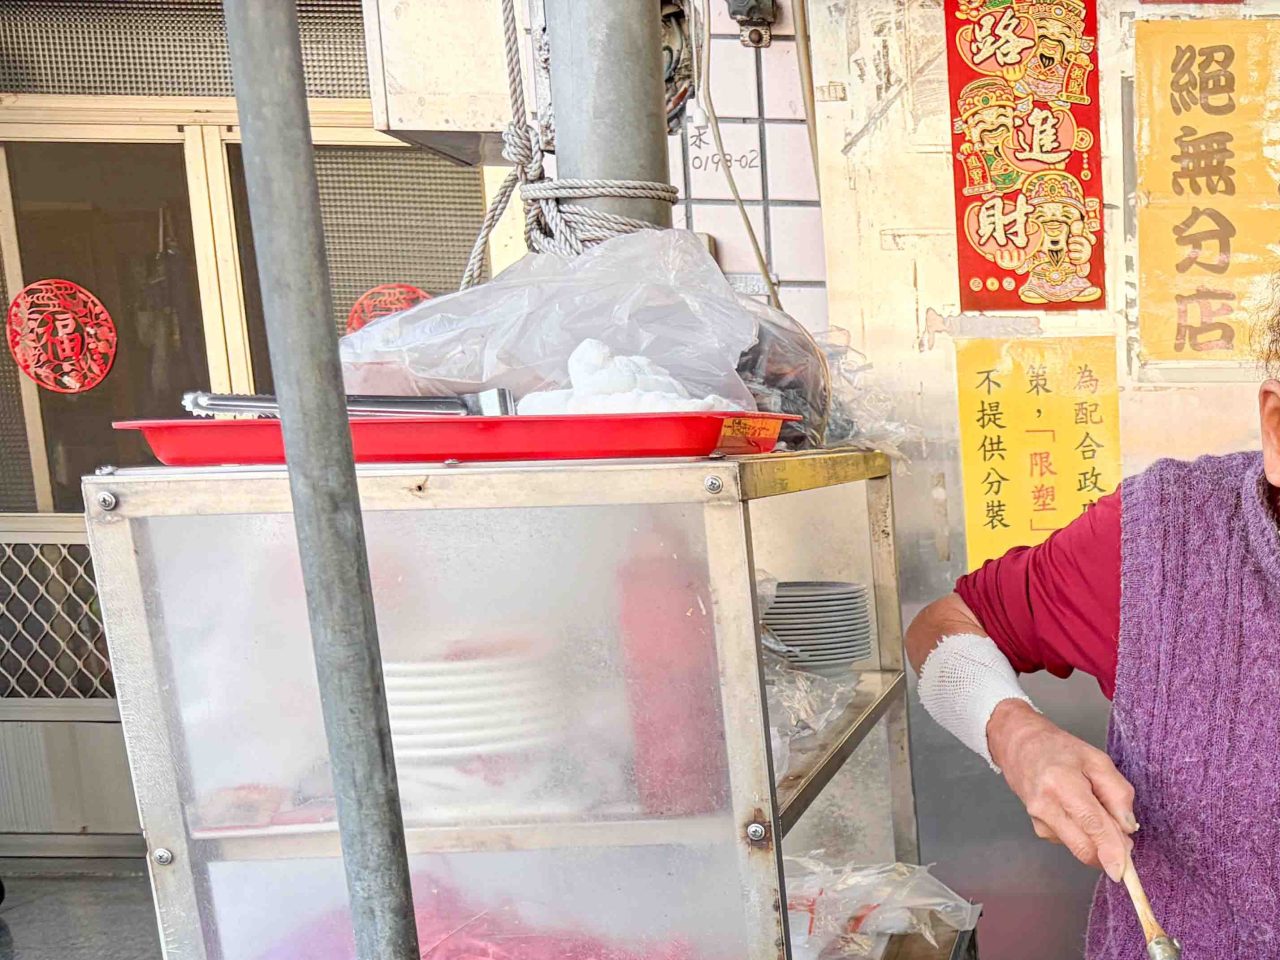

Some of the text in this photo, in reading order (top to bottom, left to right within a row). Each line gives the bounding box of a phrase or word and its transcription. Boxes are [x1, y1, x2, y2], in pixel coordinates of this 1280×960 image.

[1170, 44, 1236, 353] 絕無分店
[36, 312, 82, 361] 福
[975, 368, 1011, 530] 不提供分裝
